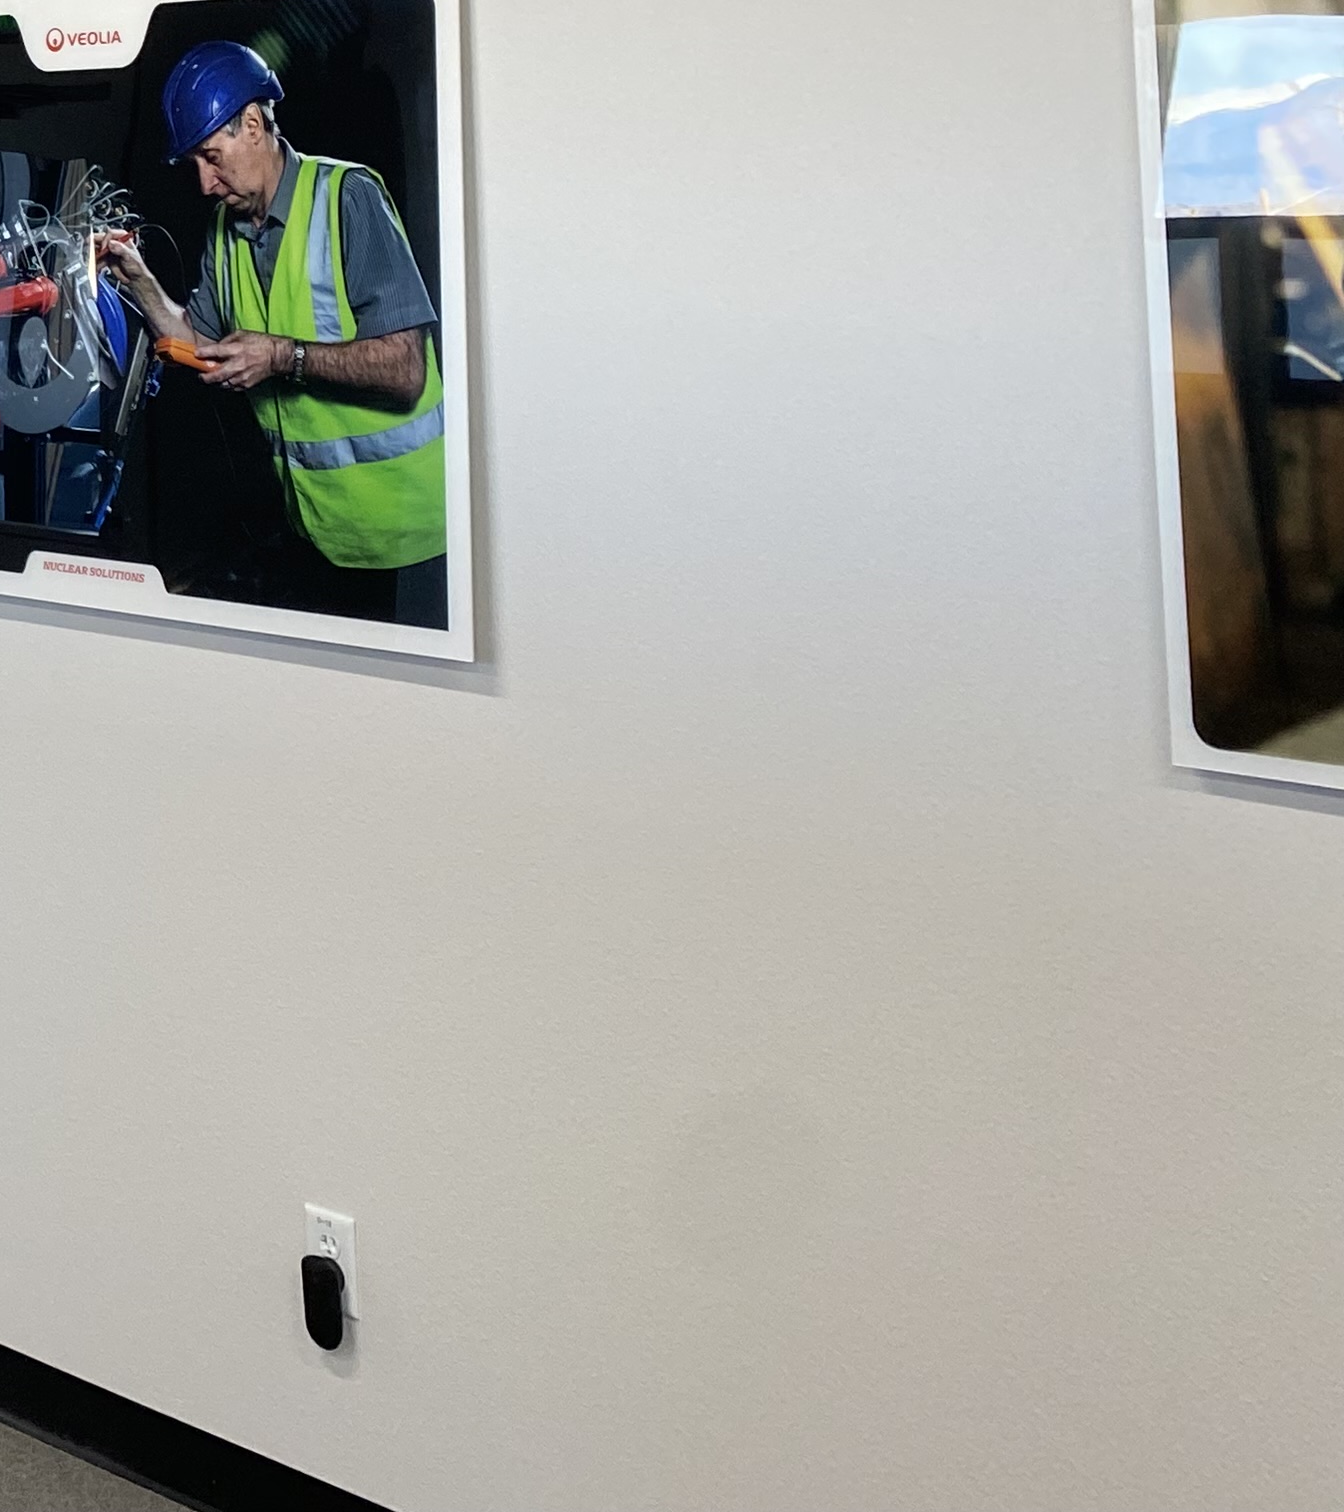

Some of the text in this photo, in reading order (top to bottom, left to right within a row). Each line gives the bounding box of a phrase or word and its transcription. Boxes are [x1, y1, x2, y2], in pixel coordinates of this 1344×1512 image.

[66, 30, 122, 46] VEOLIA
[43, 561, 145, 583] NUCLEAR SOLUTIONS
